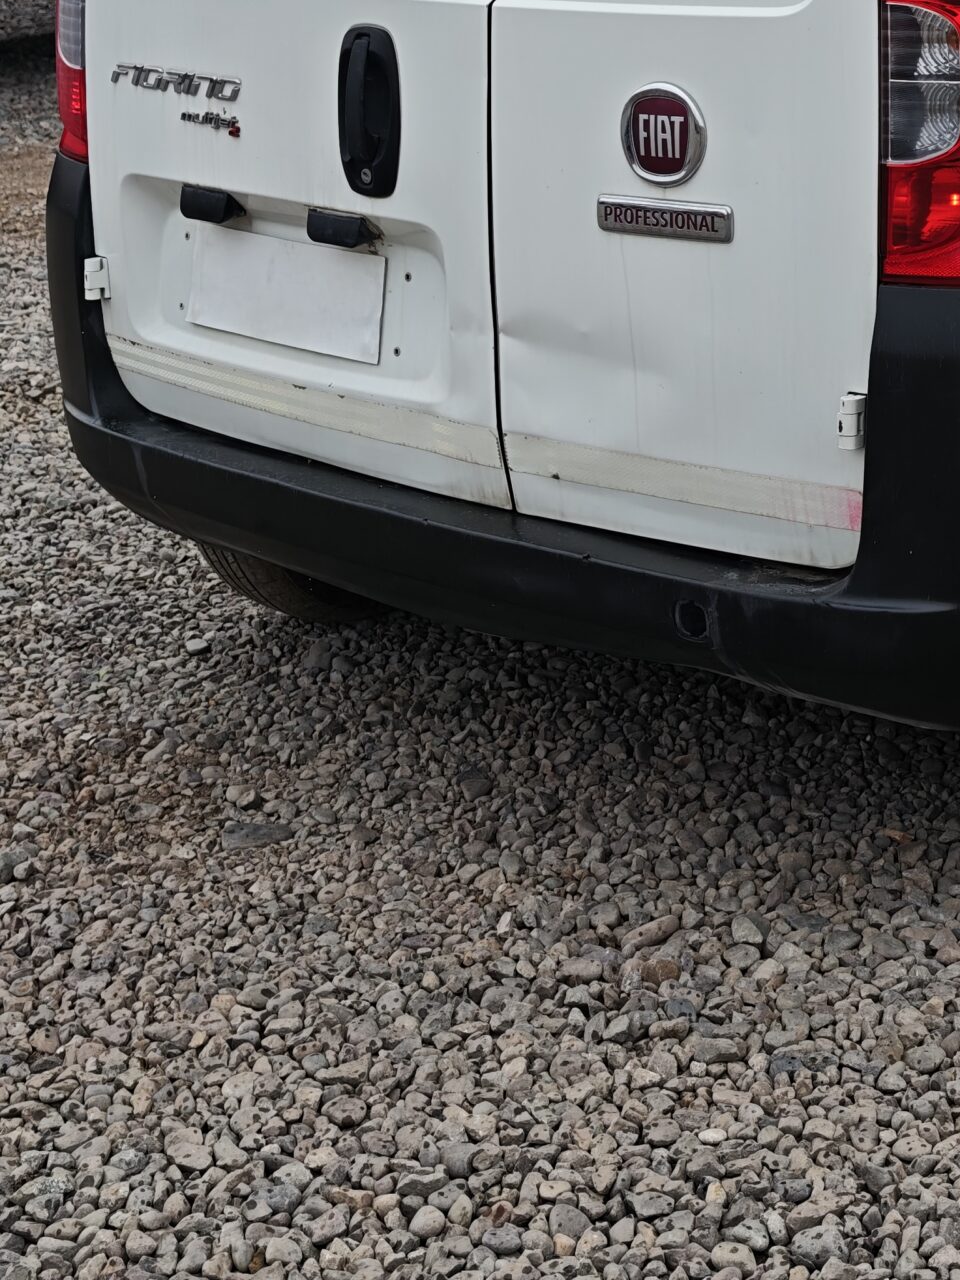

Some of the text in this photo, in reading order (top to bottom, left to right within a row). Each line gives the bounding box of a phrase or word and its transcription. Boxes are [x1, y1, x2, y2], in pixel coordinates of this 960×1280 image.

[110, 64, 241, 102] FIORINO
[638, 113, 685, 158] FIAT
[604, 206, 719, 232] PROFESSIONAL
